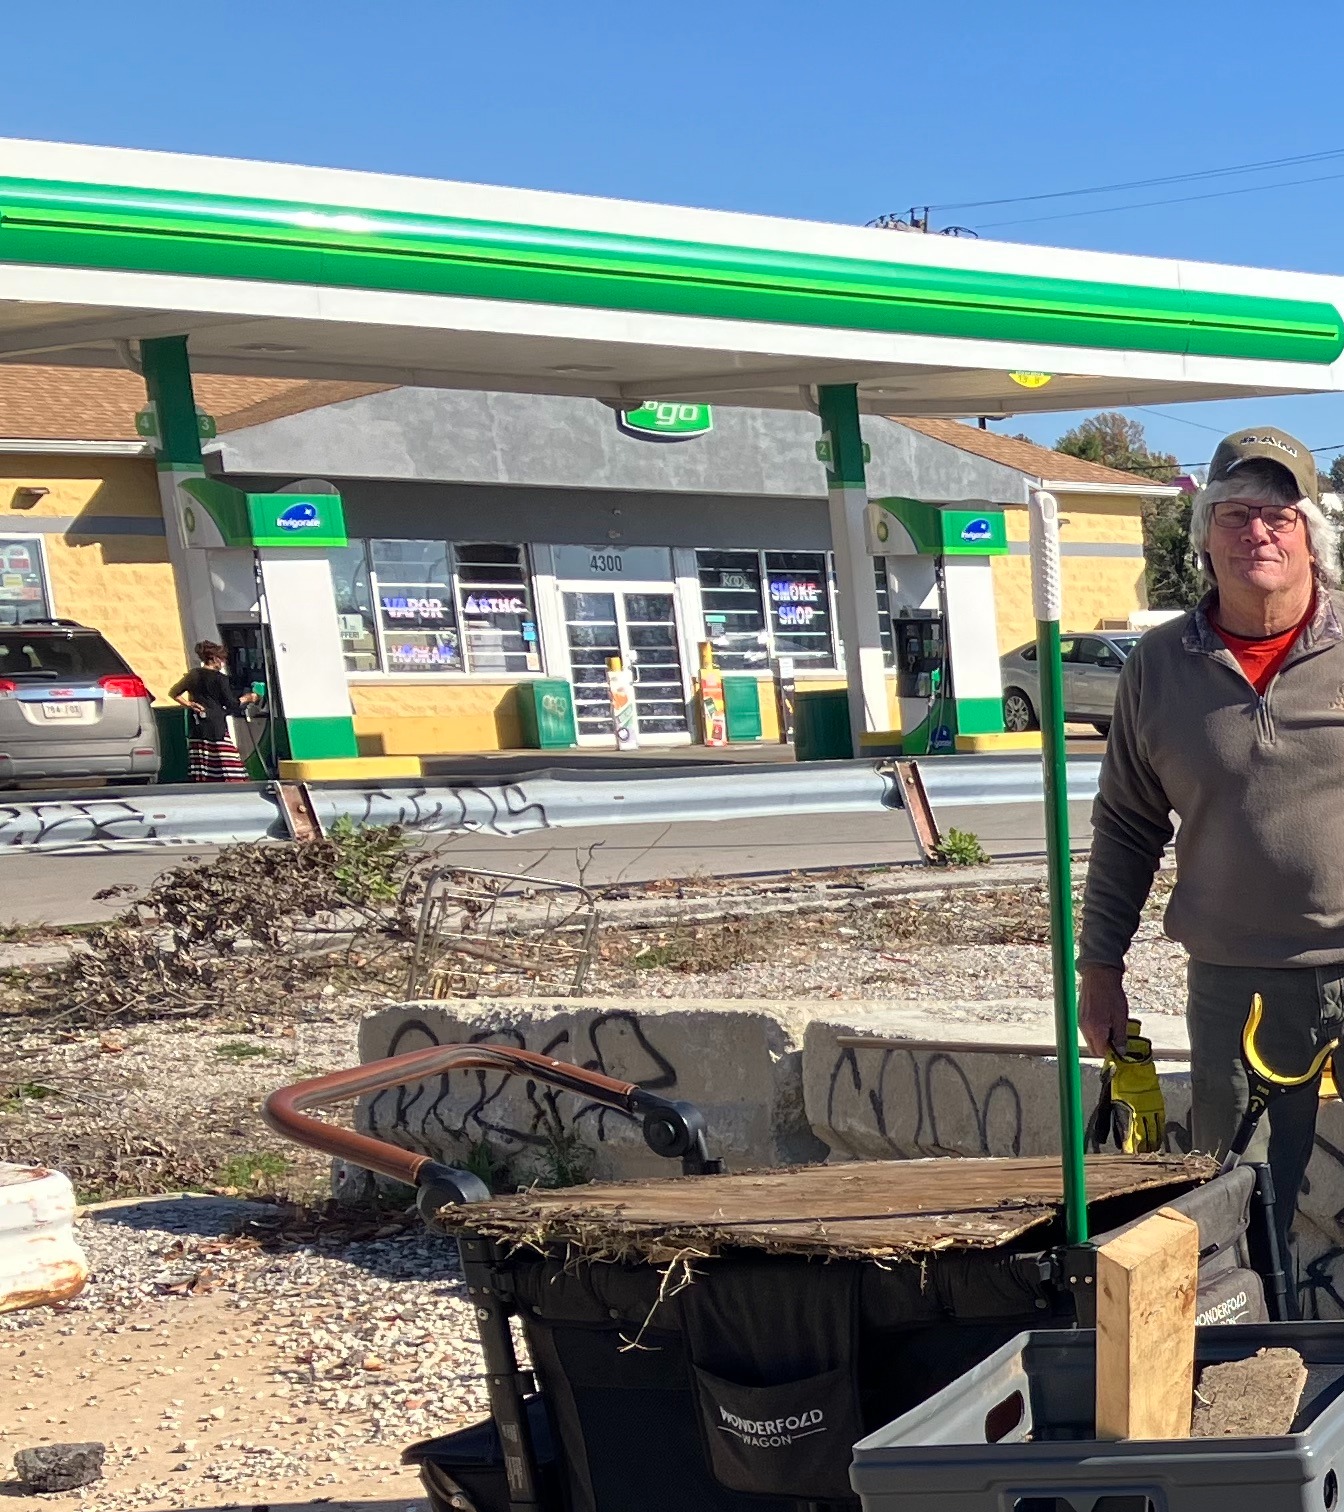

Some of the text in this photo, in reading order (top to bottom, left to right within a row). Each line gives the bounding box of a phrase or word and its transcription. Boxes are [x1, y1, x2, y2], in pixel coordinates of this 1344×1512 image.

[139, 416, 150, 429] 4
[655, 402, 699, 426] go
[201, 417, 211, 432] 3
[818, 443, 828, 456] 2
[590, 555, 623, 572] 4300
[770, 581, 818, 602] SMOKE
[383, 595, 444, 619] VAPOR
[778, 606, 814, 625] SHOP
[719, 1406, 823, 1435] WONDERFOLD
[742, 1434, 792, 1448] WAGON
